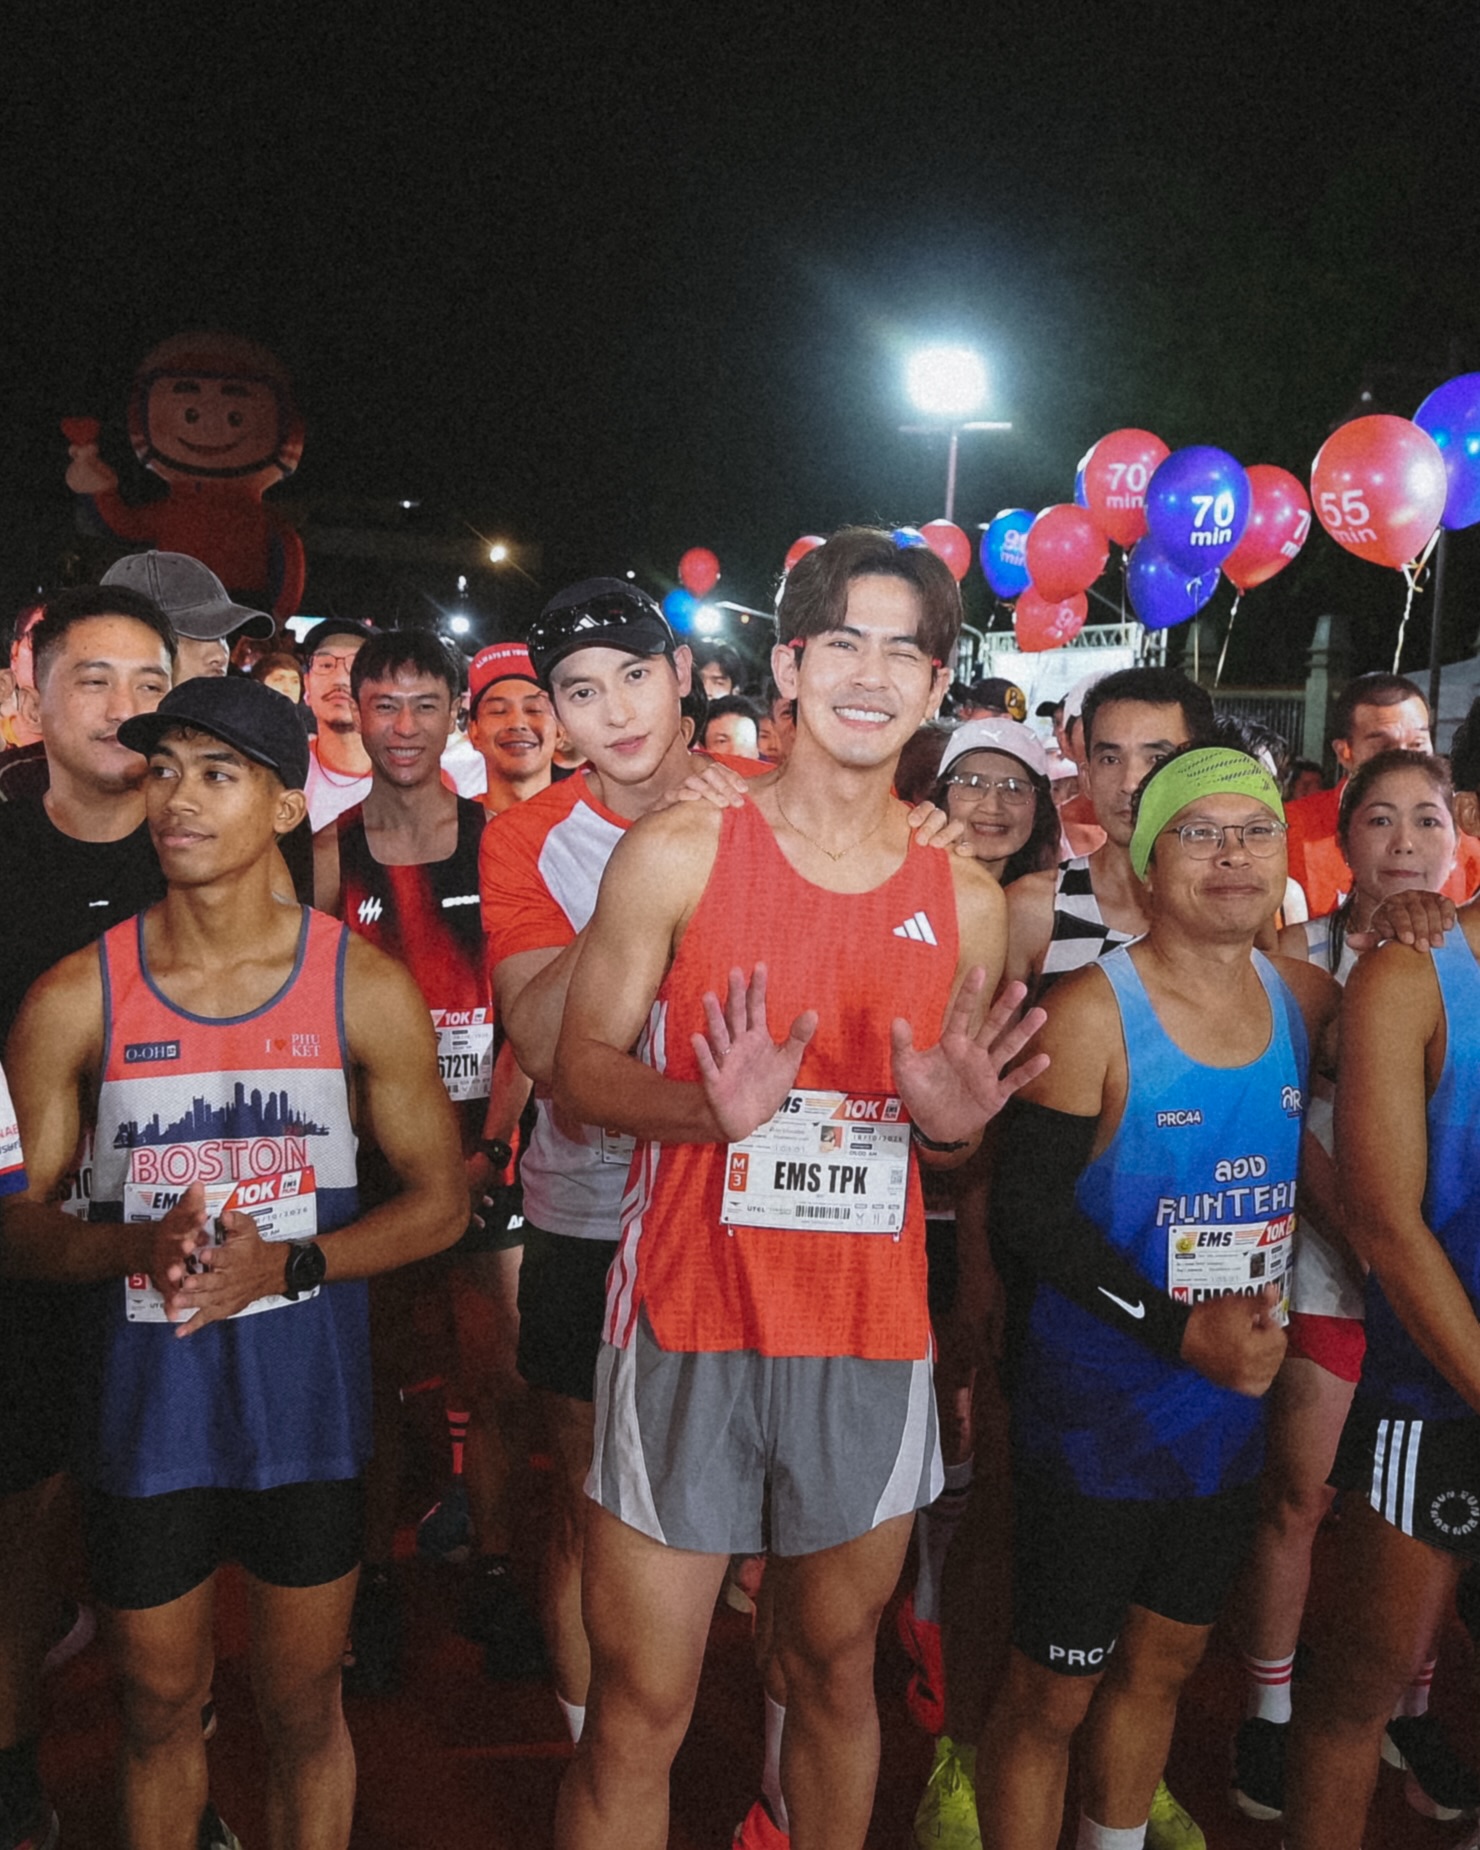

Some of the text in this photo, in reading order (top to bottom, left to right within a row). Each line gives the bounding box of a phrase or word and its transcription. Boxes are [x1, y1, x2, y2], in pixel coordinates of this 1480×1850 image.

[1108, 462, 1147, 492] 70
[1106, 495, 1144, 509] min
[1191, 493, 1235, 528] 70
[1320, 489, 1370, 527] 55
[1293, 508, 1311, 543] 7
[1330, 527, 1378, 543] min
[1190, 527, 1232, 546] min
[445, 1012, 471, 1026] 10K
[265, 1033, 320, 1053] I PHU
[292, 1045, 320, 1057] KET
[778, 1097, 803, 1113] MS
[845, 1099, 881, 1119] 10K
[1157, 1110, 1202, 1127] PRC44
[131, 1138, 307, 1185] BOSTON
[733, 1157, 745, 1170] M
[1215, 1156, 1266, 1182] ลอง
[733, 1174, 742, 1187] 3
[774, 1161, 868, 1194] EMS TPK
[152, 1179, 277, 1209] EM 10K
[1197, 1231, 1234, 1248] EMS
[1266, 1219, 1287, 1243] 10K
[1174, 1290, 1188, 1303] M
